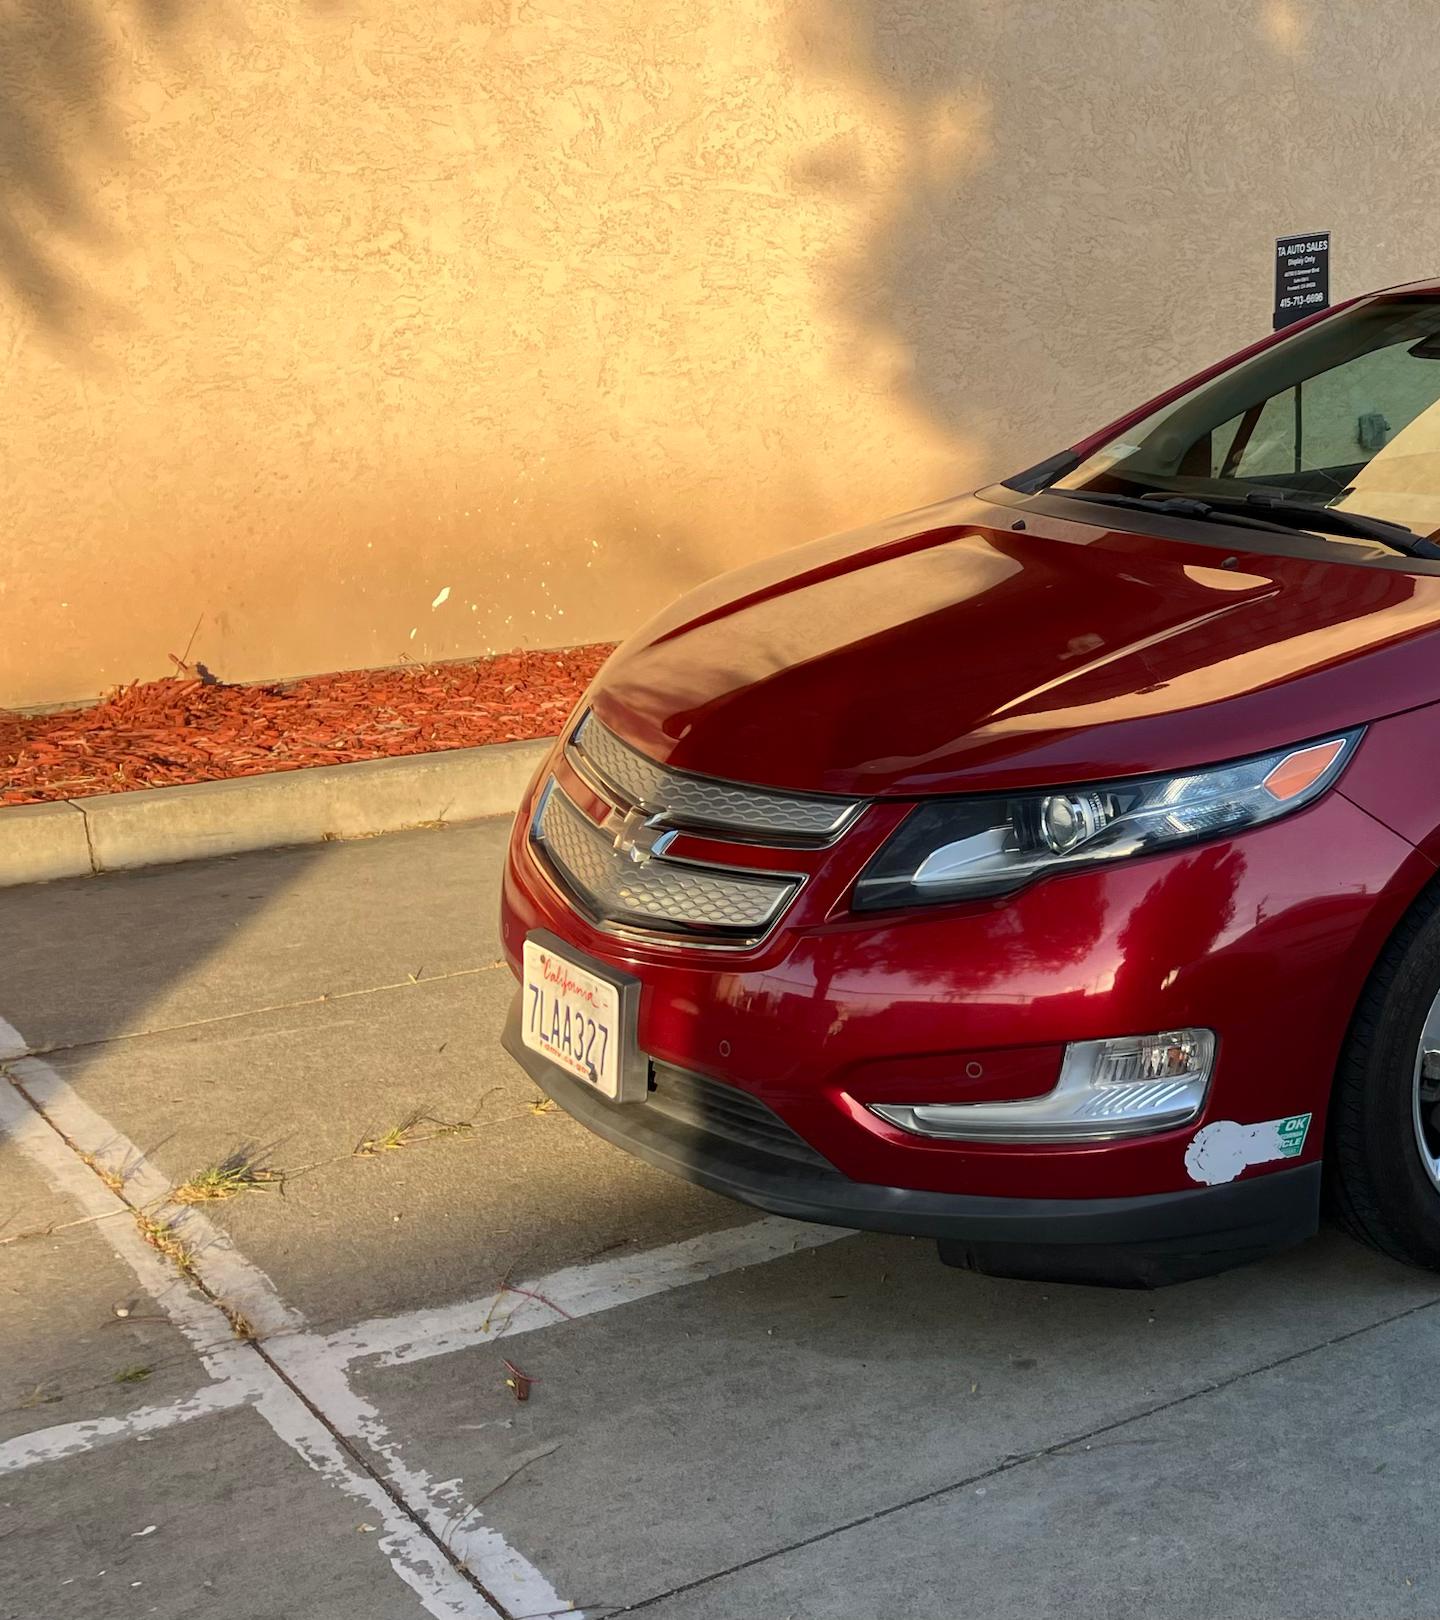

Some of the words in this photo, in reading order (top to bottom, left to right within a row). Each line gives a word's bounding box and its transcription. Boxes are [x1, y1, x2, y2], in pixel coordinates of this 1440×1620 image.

[1278, 246, 1287, 257] TA
[1287, 244, 1305, 255] AUTO
[1306, 240, 1328, 252] SALES
[1304, 255, 1316, 264] Only
[543, 958, 599, 1008] California
[529, 983, 608, 1076] 7LAA327
[1285, 1116, 1308, 1131] OK
